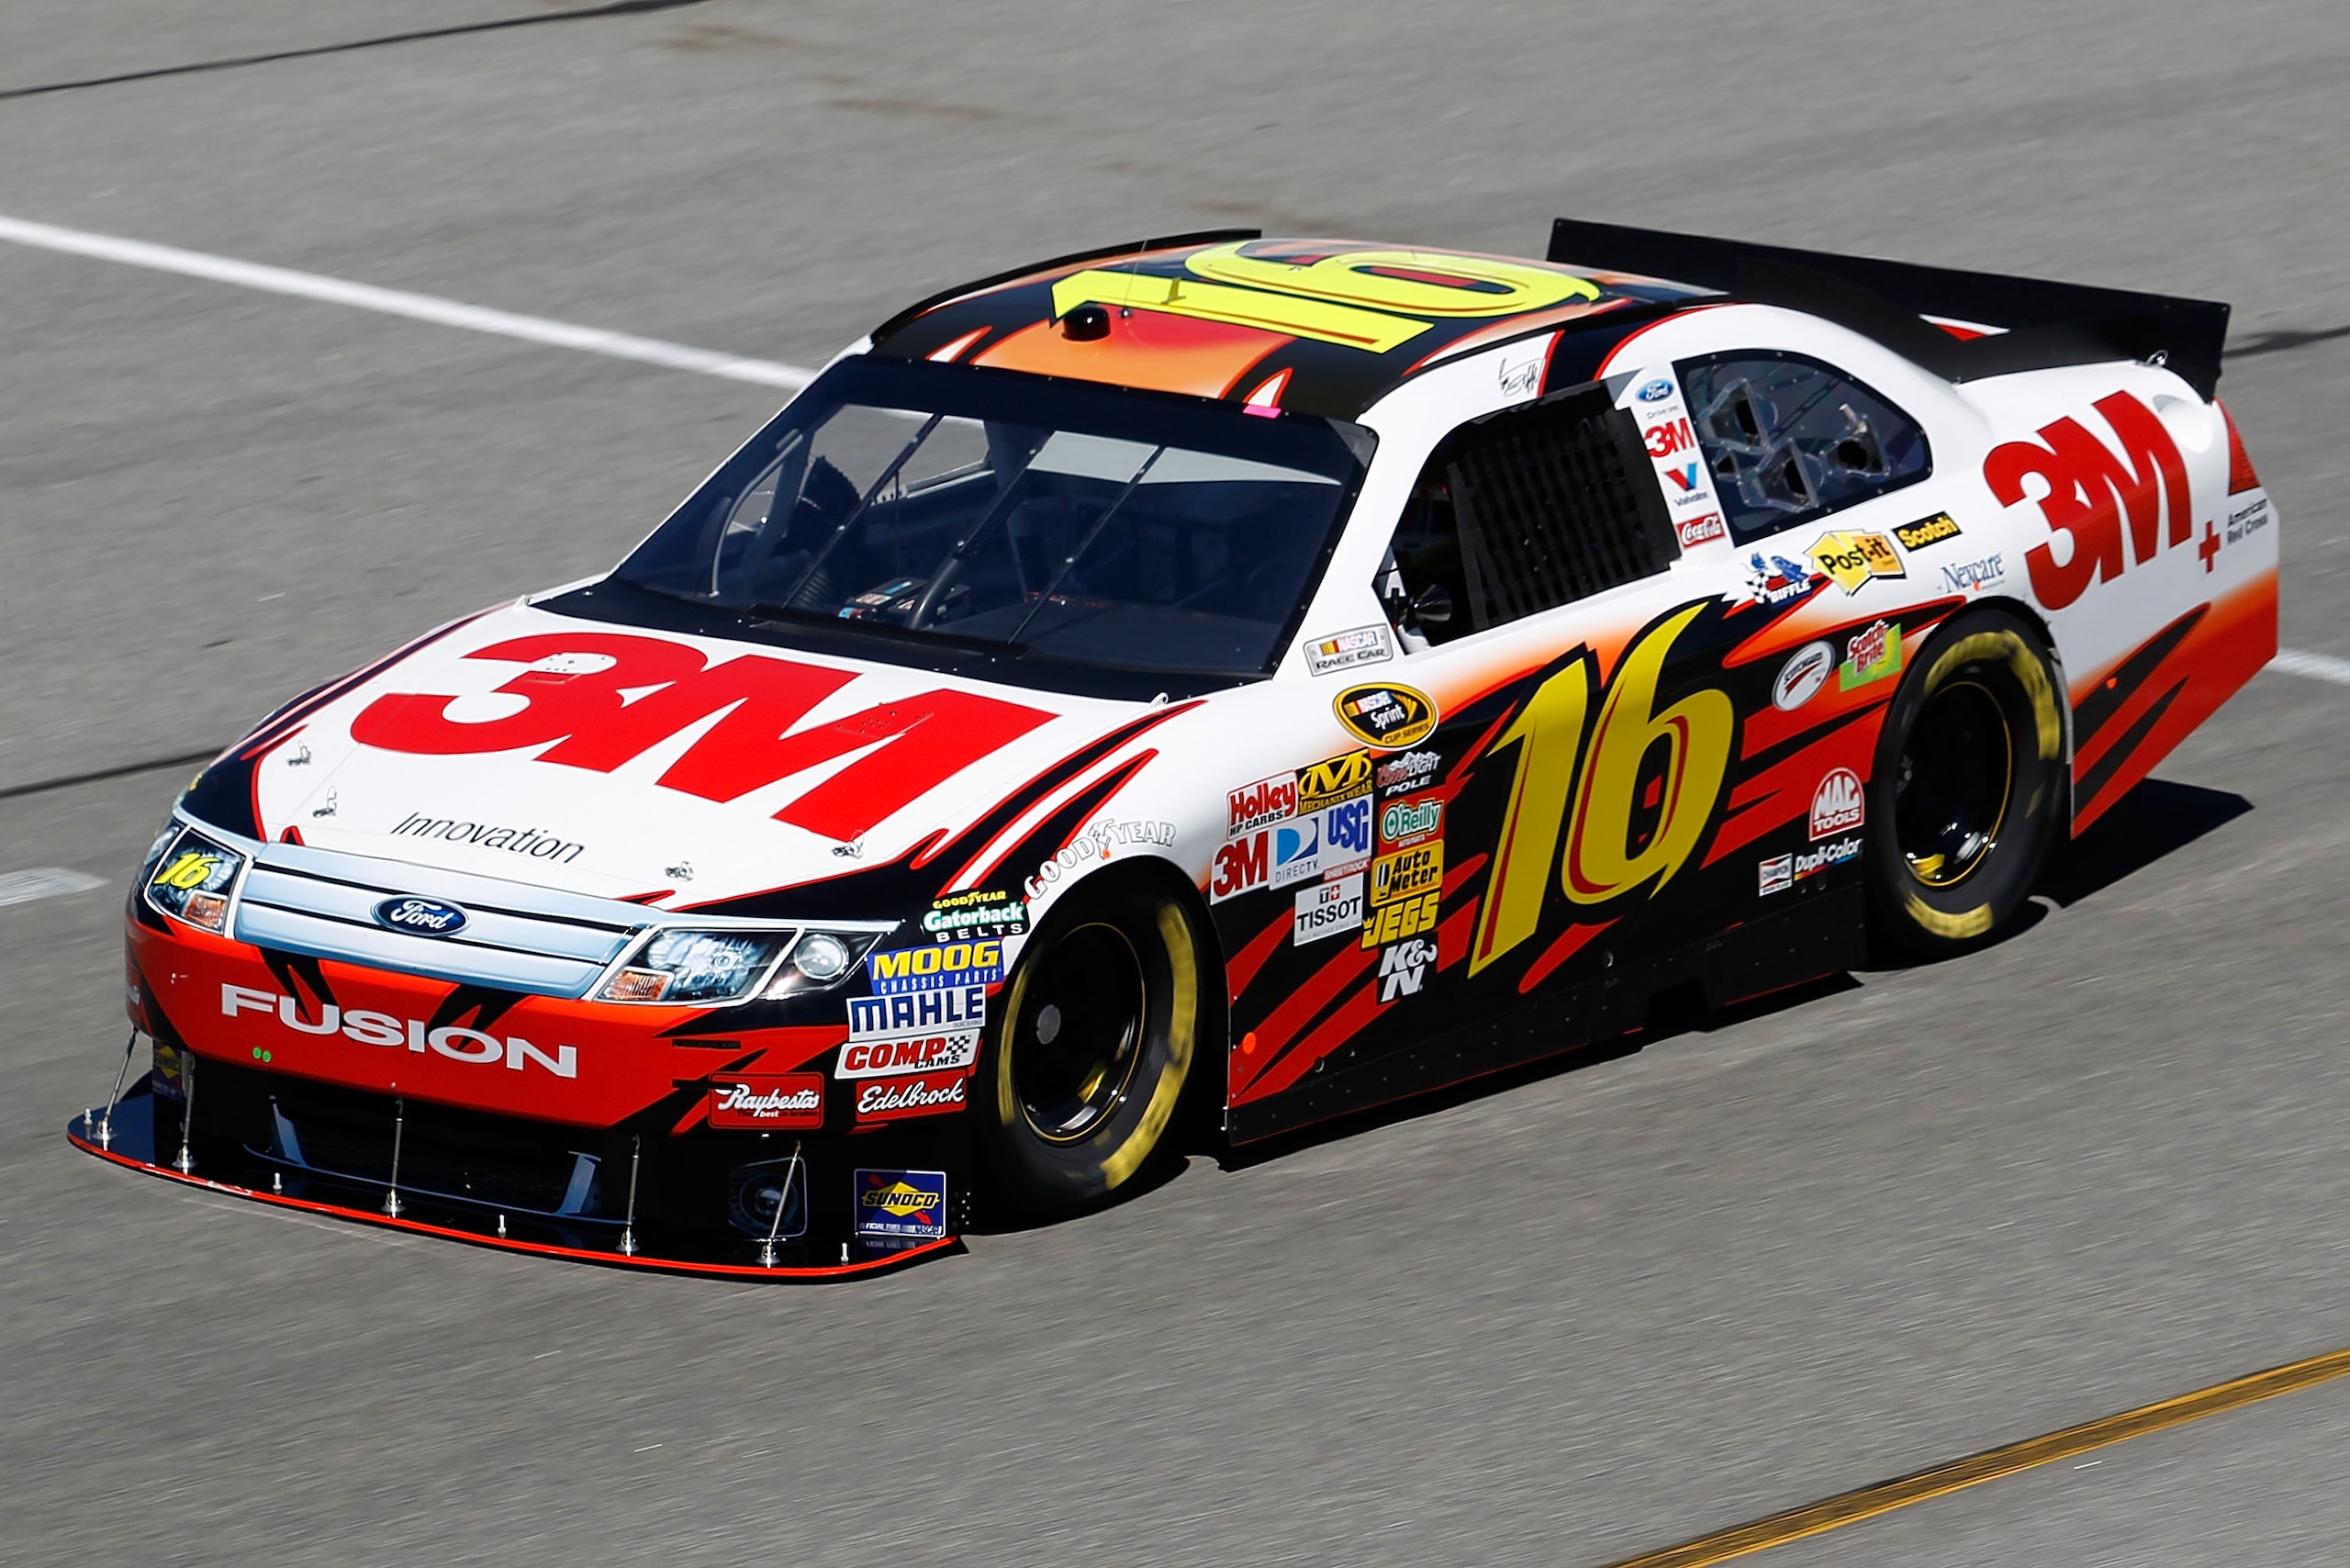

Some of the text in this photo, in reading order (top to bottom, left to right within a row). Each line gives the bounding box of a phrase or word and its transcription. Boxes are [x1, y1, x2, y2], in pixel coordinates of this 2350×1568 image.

[1051, 241, 1601, 354] 16
[1644, 417, 1695, 458] 3M
[1983, 389, 2192, 610] 3M
[1897, 515, 1959, 549] Scotch
[1818, 537, 1892, 576] Post-it
[1940, 552, 2006, 594] Nexcare
[1768, 579, 1812, 606] BIFFLE
[1315, 647, 1386, 670] RACE CAR
[1855, 642, 1884, 674] Brite
[1370, 703, 1406, 730] Sprint
[1384, 722, 1429, 745] CUP SERIES
[350, 632, 1061, 843] 3M
[1229, 781, 1296, 826] Holley
[1298, 779, 1374, 815] MECHANIX WEAR
[1385, 774, 1432, 797] POLE
[1468, 599, 1734, 980] 16
[1814, 774, 1861, 822] MAC
[390, 811, 586, 866] Innovation
[1229, 810, 1284, 837] HP CARBS
[1327, 799, 1369, 853] USG
[1382, 801, 1442, 841] O'Reilly
[1814, 808, 1861, 833] TOOLS
[154, 852, 222, 890] 16
[1024, 818, 1177, 900] GOODYEAR
[1213, 830, 1269, 898] 3M
[1275, 859, 1320, 883] DIRECTV
[1393, 849, 1431, 876] Auto
[1795, 836, 1864, 873] Dupli-Color
[1389, 867, 1439, 893] Meter
[388, 898, 453, 931] Ford
[923, 901, 1025, 933] Gatorback
[932, 890, 1007, 910] GOODYEAR
[1296, 896, 1362, 933] TISSOT
[935, 923, 1024, 944] BELTS
[1361, 891, 1441, 950] JEGS
[872, 940, 1001, 981] MOOG
[880, 974, 945, 995] CHASSIS
[850, 986, 984, 1034] MAHLE
[220, 983, 577, 1079] FUSION
[844, 1036, 947, 1071] COMP
[914, 1054, 961, 1070] CAMS
[714, 1083, 821, 1118] Raybestos
[856, 1077, 966, 1114] Edelbrock
[759, 1110, 780, 1118] best
[863, 1192, 939, 1208] SUNOCO
